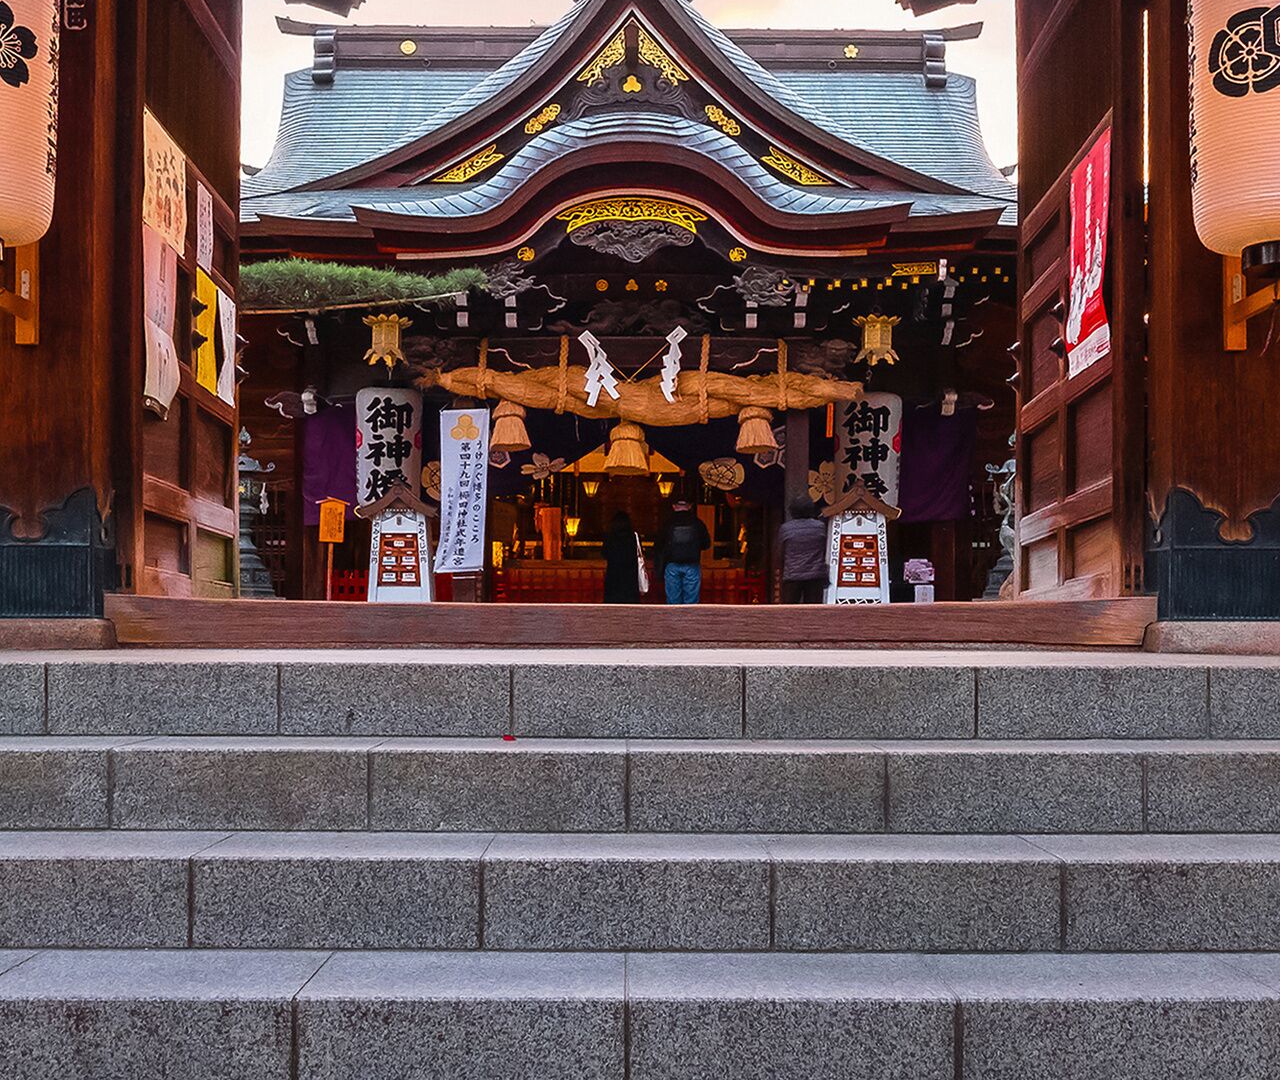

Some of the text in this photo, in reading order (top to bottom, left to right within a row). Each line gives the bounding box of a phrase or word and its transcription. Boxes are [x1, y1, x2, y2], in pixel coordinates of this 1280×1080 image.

[470, 439, 484, 544] うけつぐ博多のこころ
